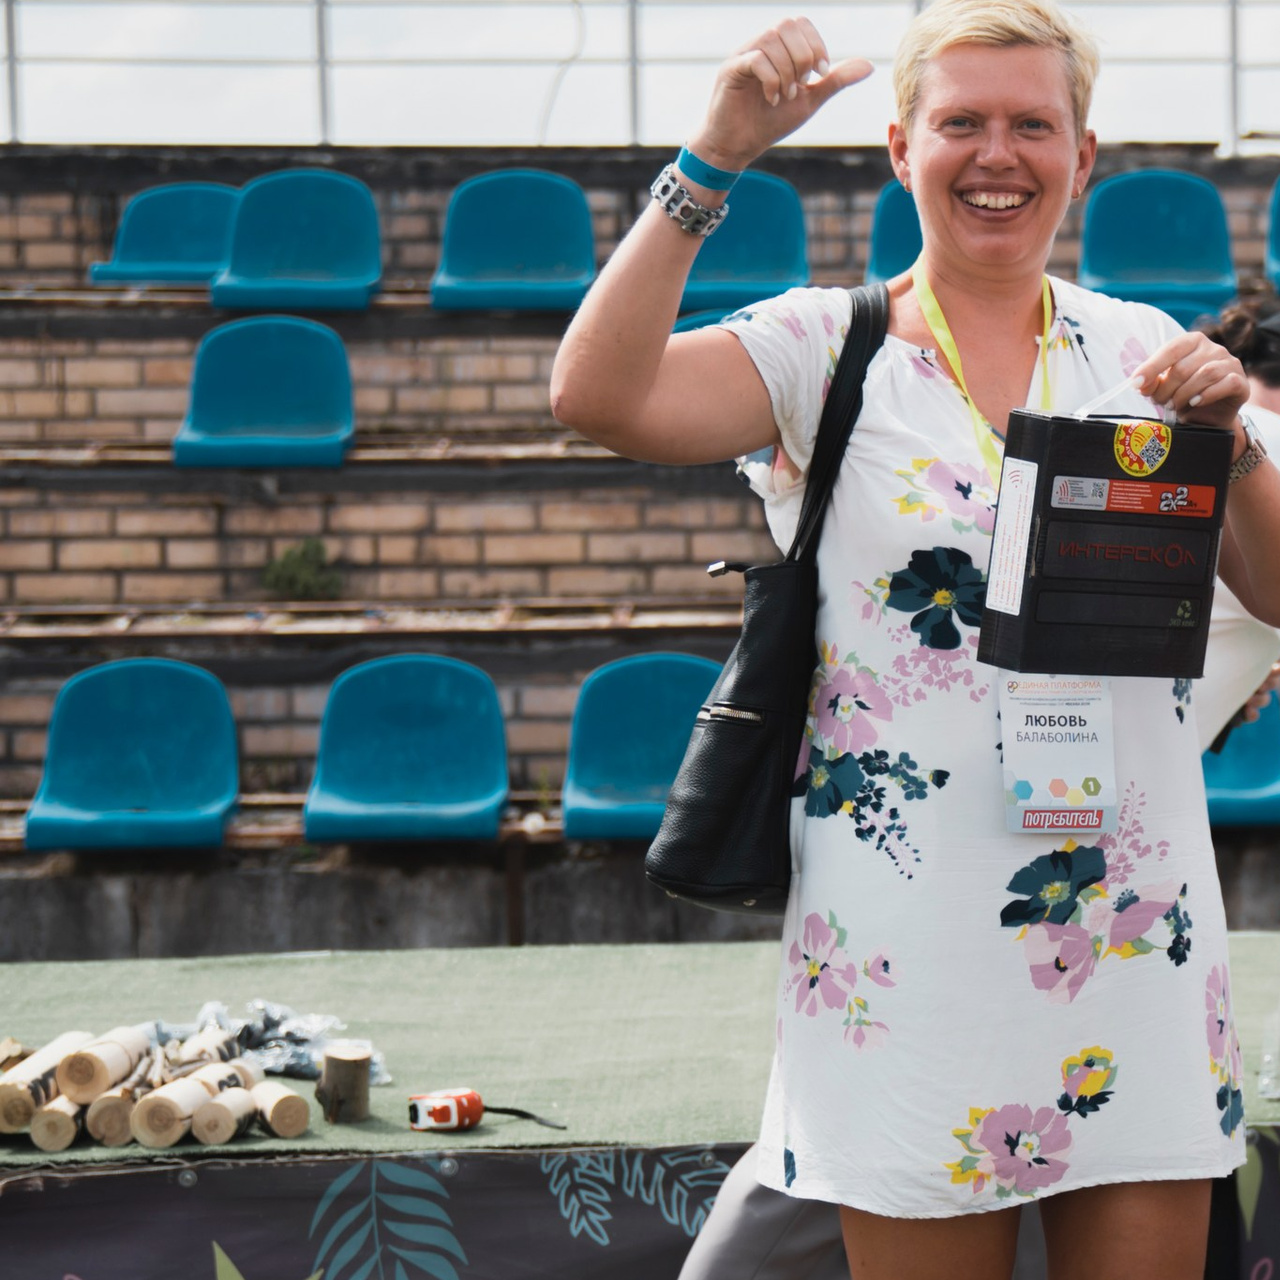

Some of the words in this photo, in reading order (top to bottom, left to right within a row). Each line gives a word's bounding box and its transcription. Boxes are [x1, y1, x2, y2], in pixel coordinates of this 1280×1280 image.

[1058, 539, 1197, 569] ИНТЕРСКОЛ
[1018, 681, 1050, 690] ЕДИНАЯ
[1050, 680, 1102, 690] ПЛАТФОРМА
[1024, 714, 1087, 727] ЛЮБОВЬ
[1016, 731, 1099, 743] БАЛАБОЛИНА
[1088, 781, 1095, 792] 1
